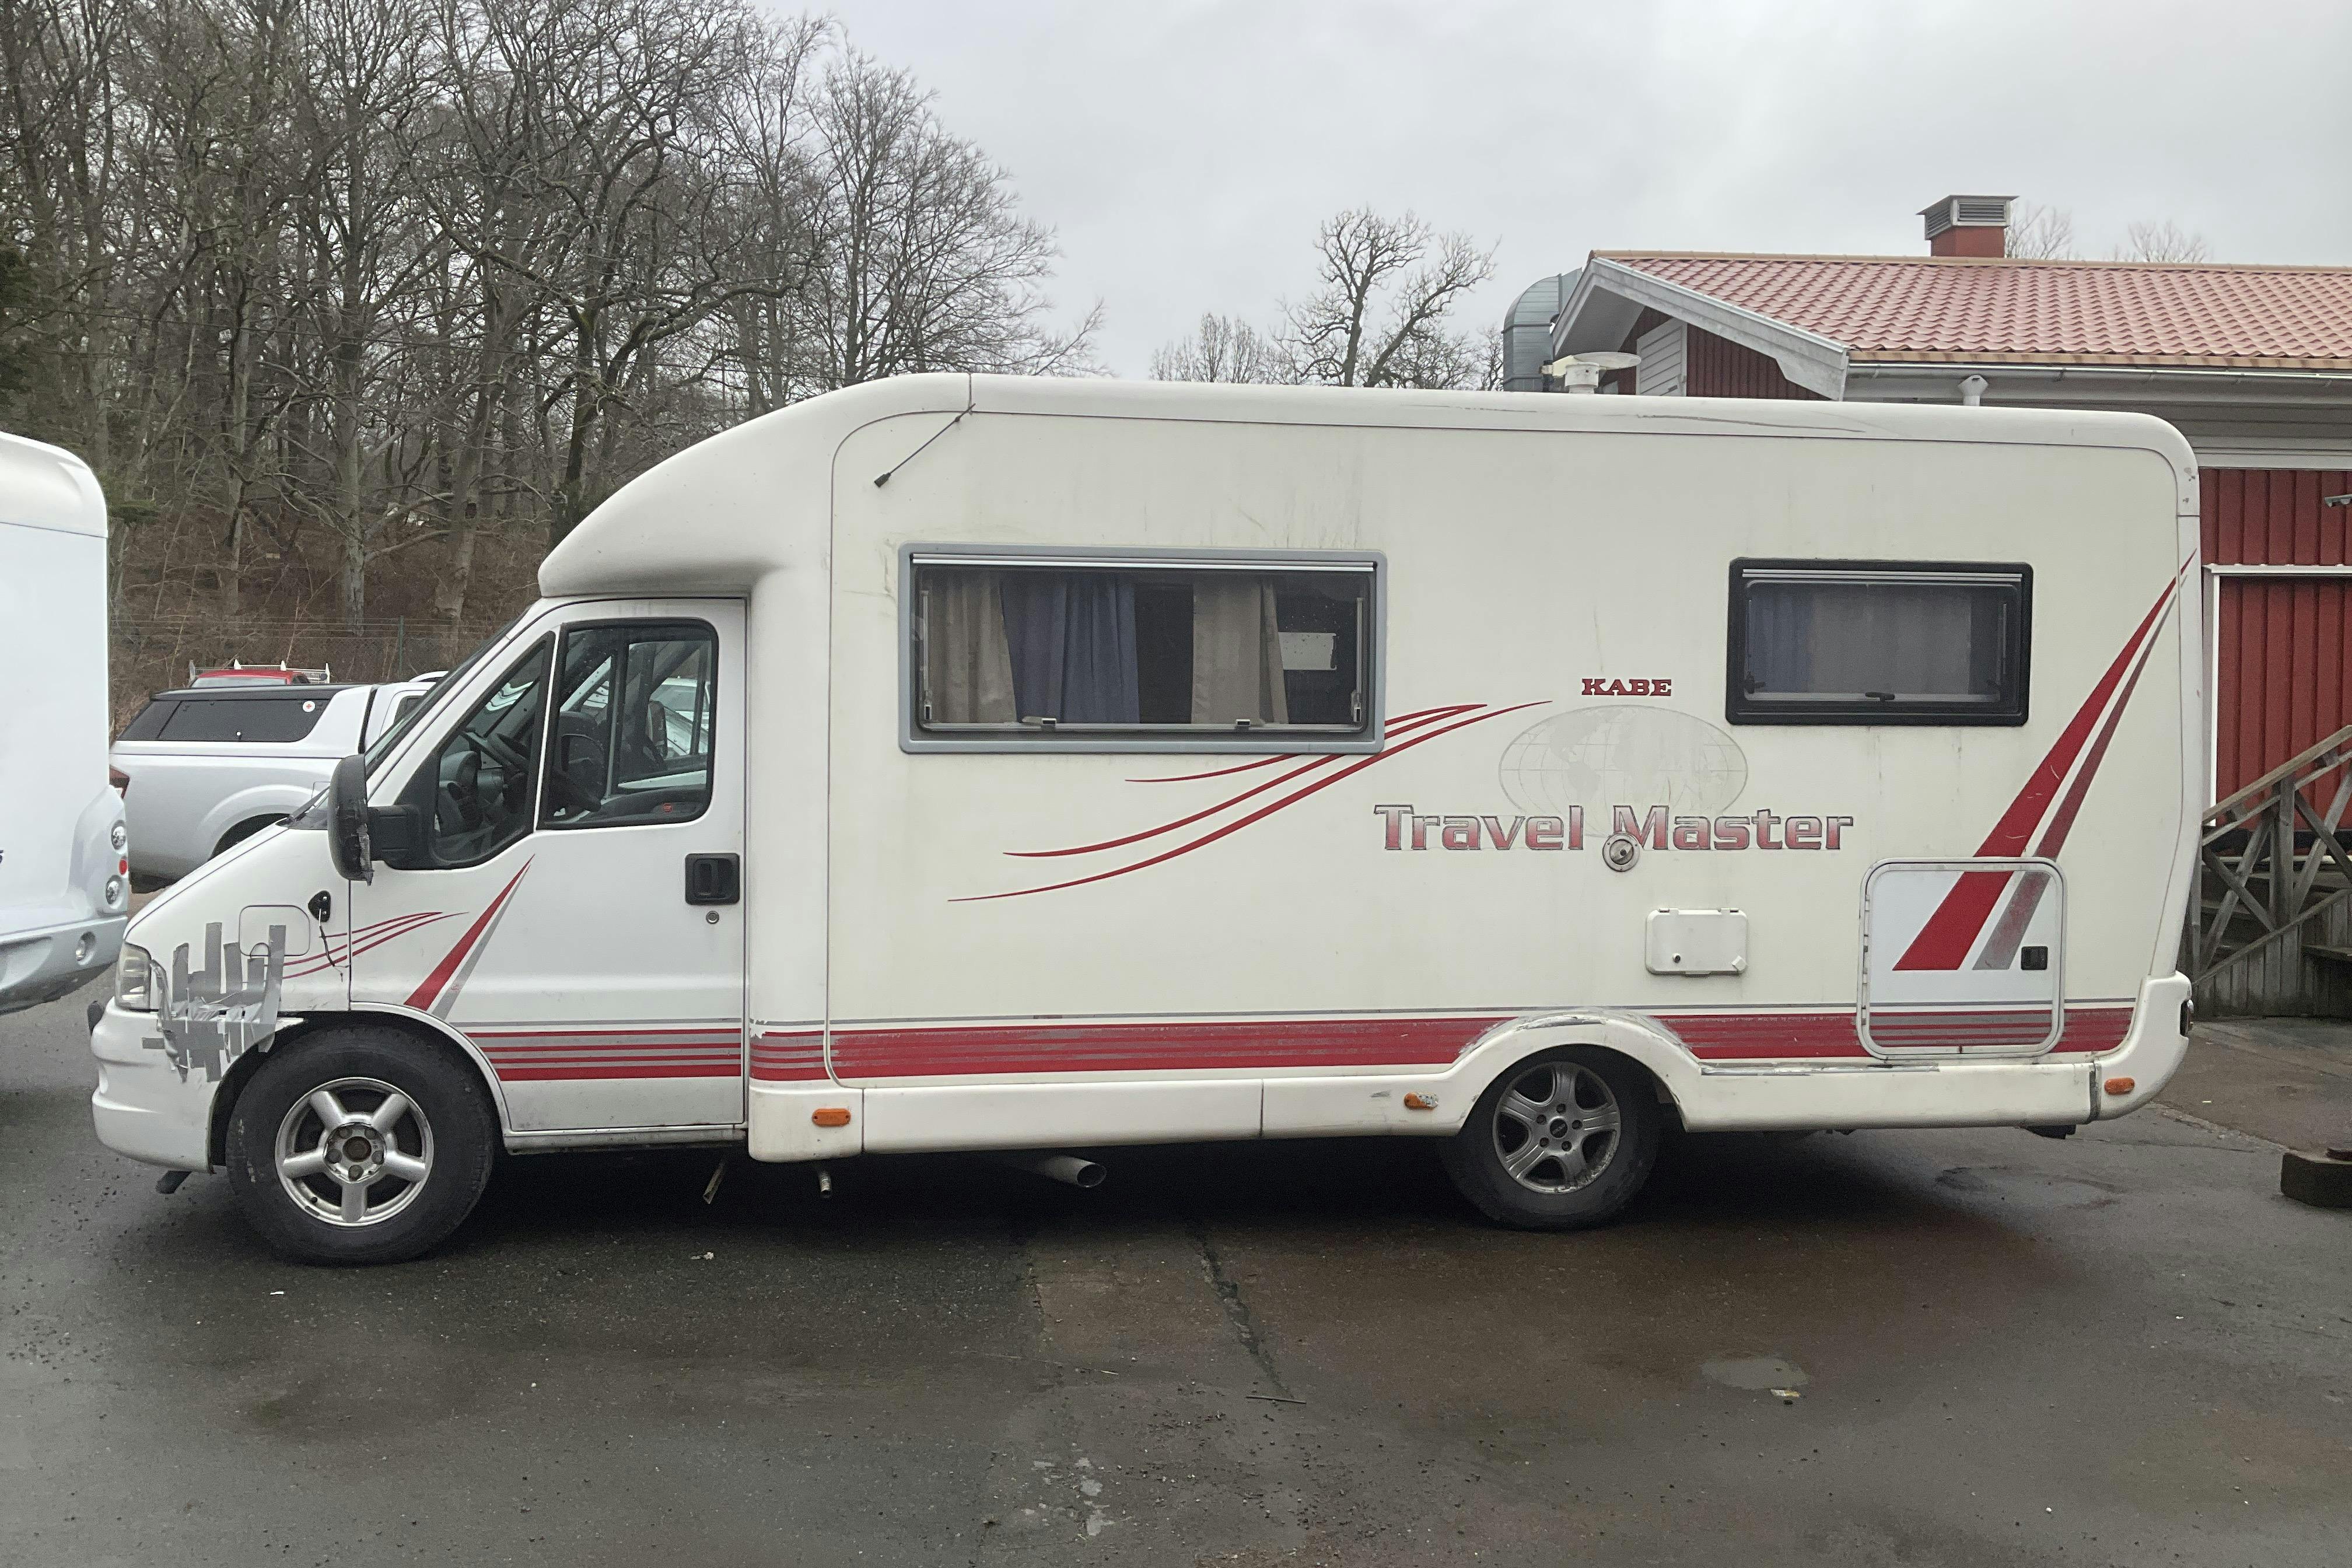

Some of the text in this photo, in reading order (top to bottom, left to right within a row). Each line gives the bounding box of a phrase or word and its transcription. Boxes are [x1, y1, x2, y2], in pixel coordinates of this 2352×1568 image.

[1581, 678, 1672, 696] KABE
[1373, 804, 1854, 850] Travel Master
